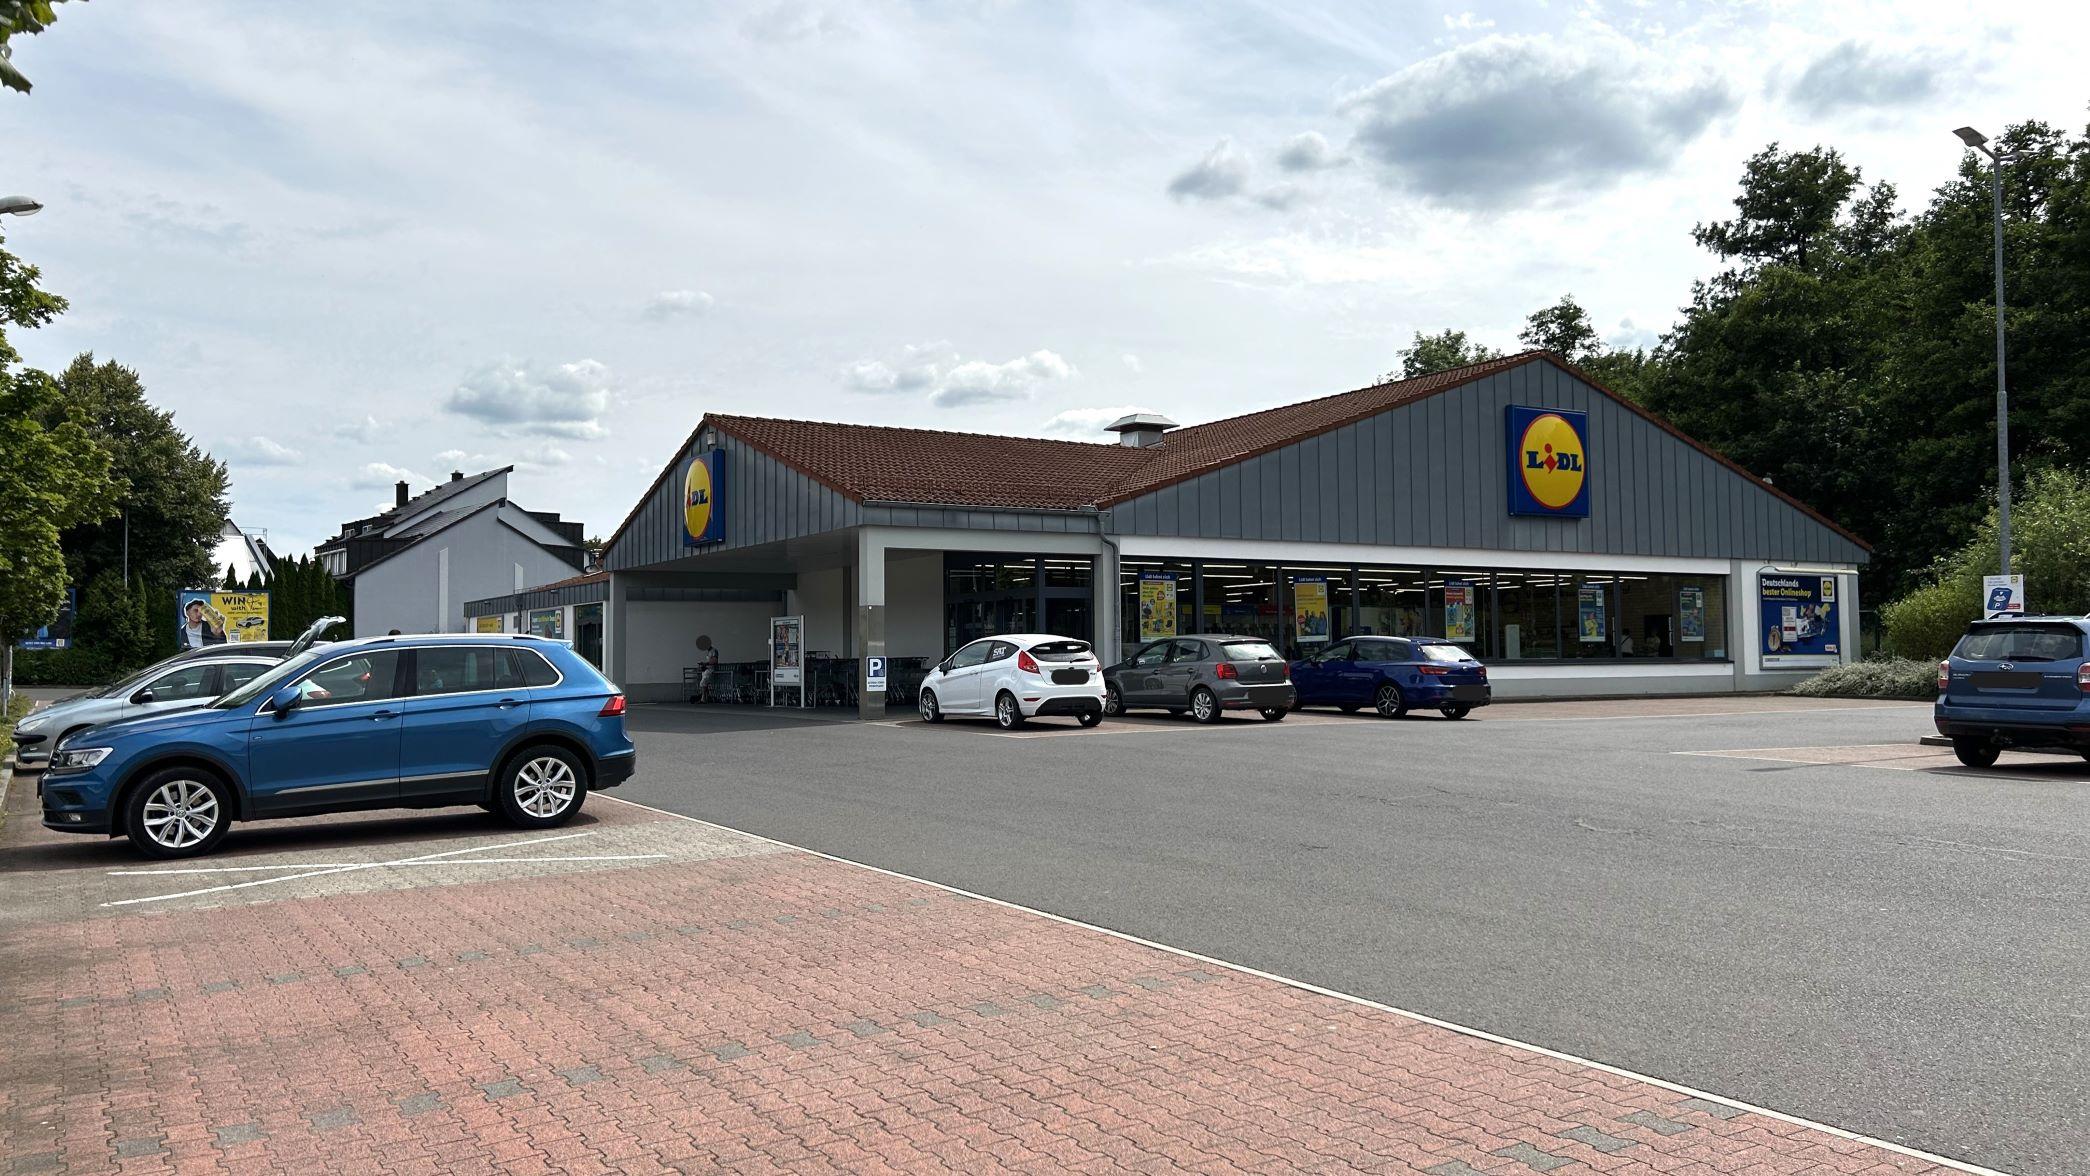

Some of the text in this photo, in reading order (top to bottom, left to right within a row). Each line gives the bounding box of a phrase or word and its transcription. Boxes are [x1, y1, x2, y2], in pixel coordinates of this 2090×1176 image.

[1526, 443, 1582, 474] LIDL
[1761, 578, 1799, 588] Deutschlands
[1762, 587, 1812, 599] bester Onlineshop
[221, 596, 246, 606] WIN
[869, 658, 882, 677] P
